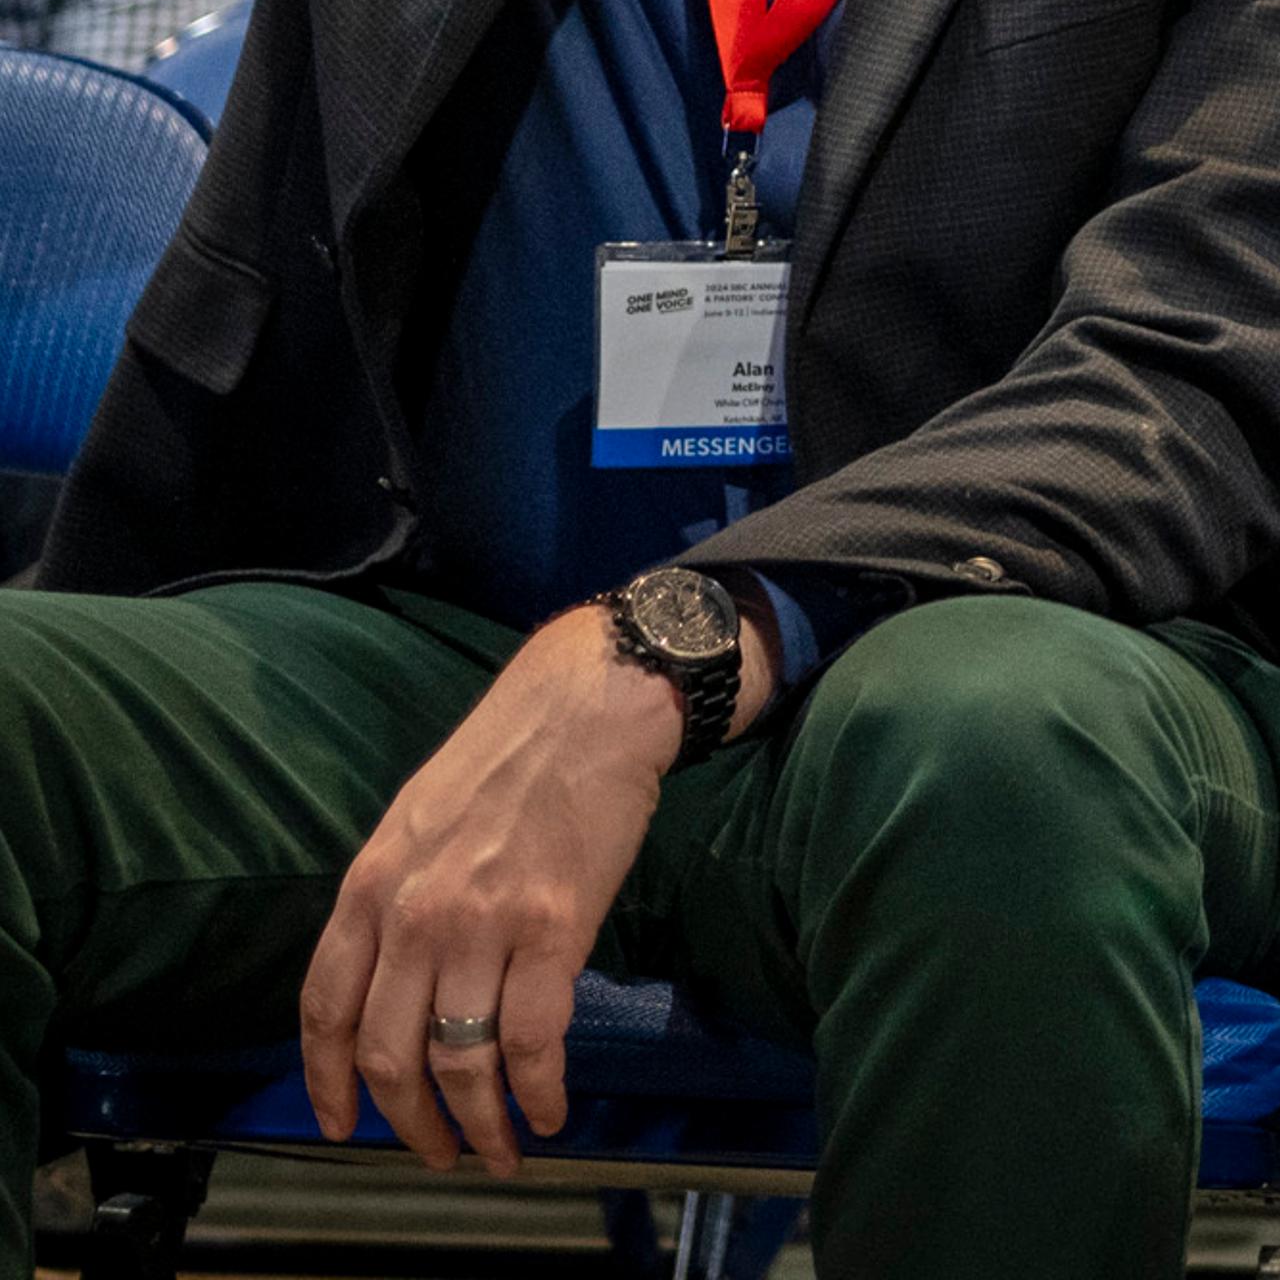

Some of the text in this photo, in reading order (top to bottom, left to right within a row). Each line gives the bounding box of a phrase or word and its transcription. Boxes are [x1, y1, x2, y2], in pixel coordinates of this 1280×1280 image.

[626, 296, 694, 315] ONE VOICE
[627, 288, 688, 305] ONE MIND
[732, 361, 775, 378] Alan
[662, 436, 793, 457] MESSENGE
